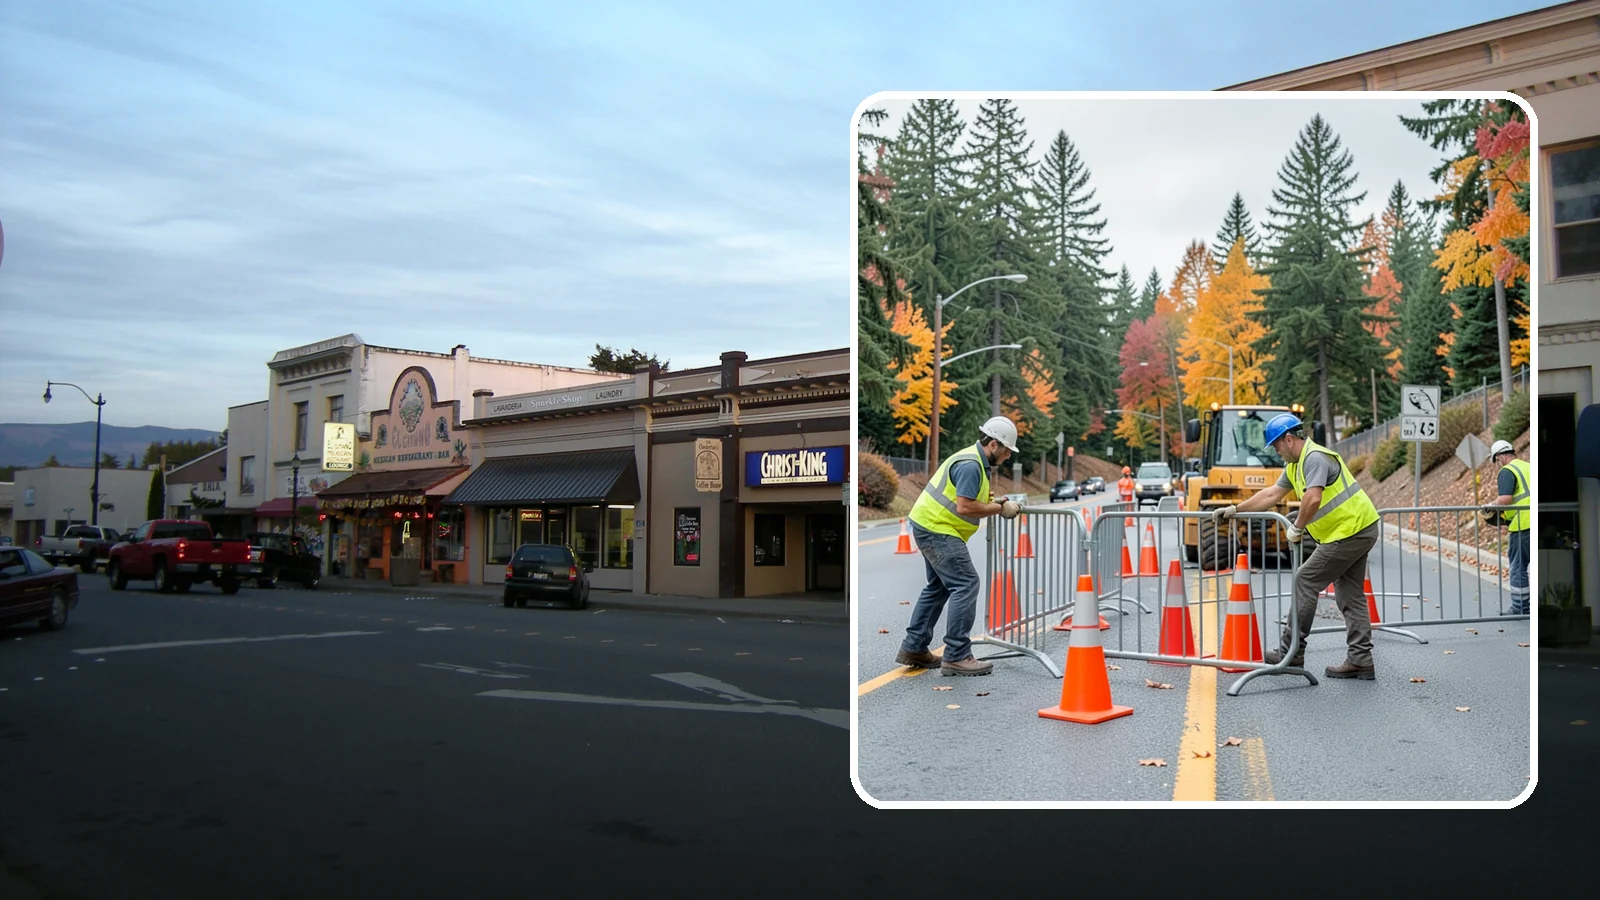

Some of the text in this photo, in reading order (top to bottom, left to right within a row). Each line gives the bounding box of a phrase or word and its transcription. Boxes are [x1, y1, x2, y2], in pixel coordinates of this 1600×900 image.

[596, 389, 623, 400] LAUNDRY
[493, 402, 522, 412] LAVANDERIA
[530, 395, 582, 409] Sparkle Shop
[397, 451, 433, 462] RESTAURANT
[437, 450, 449, 459] BAR
[761, 450, 828, 478] CHRIST KING
[697, 481, 709, 489] Coffee
